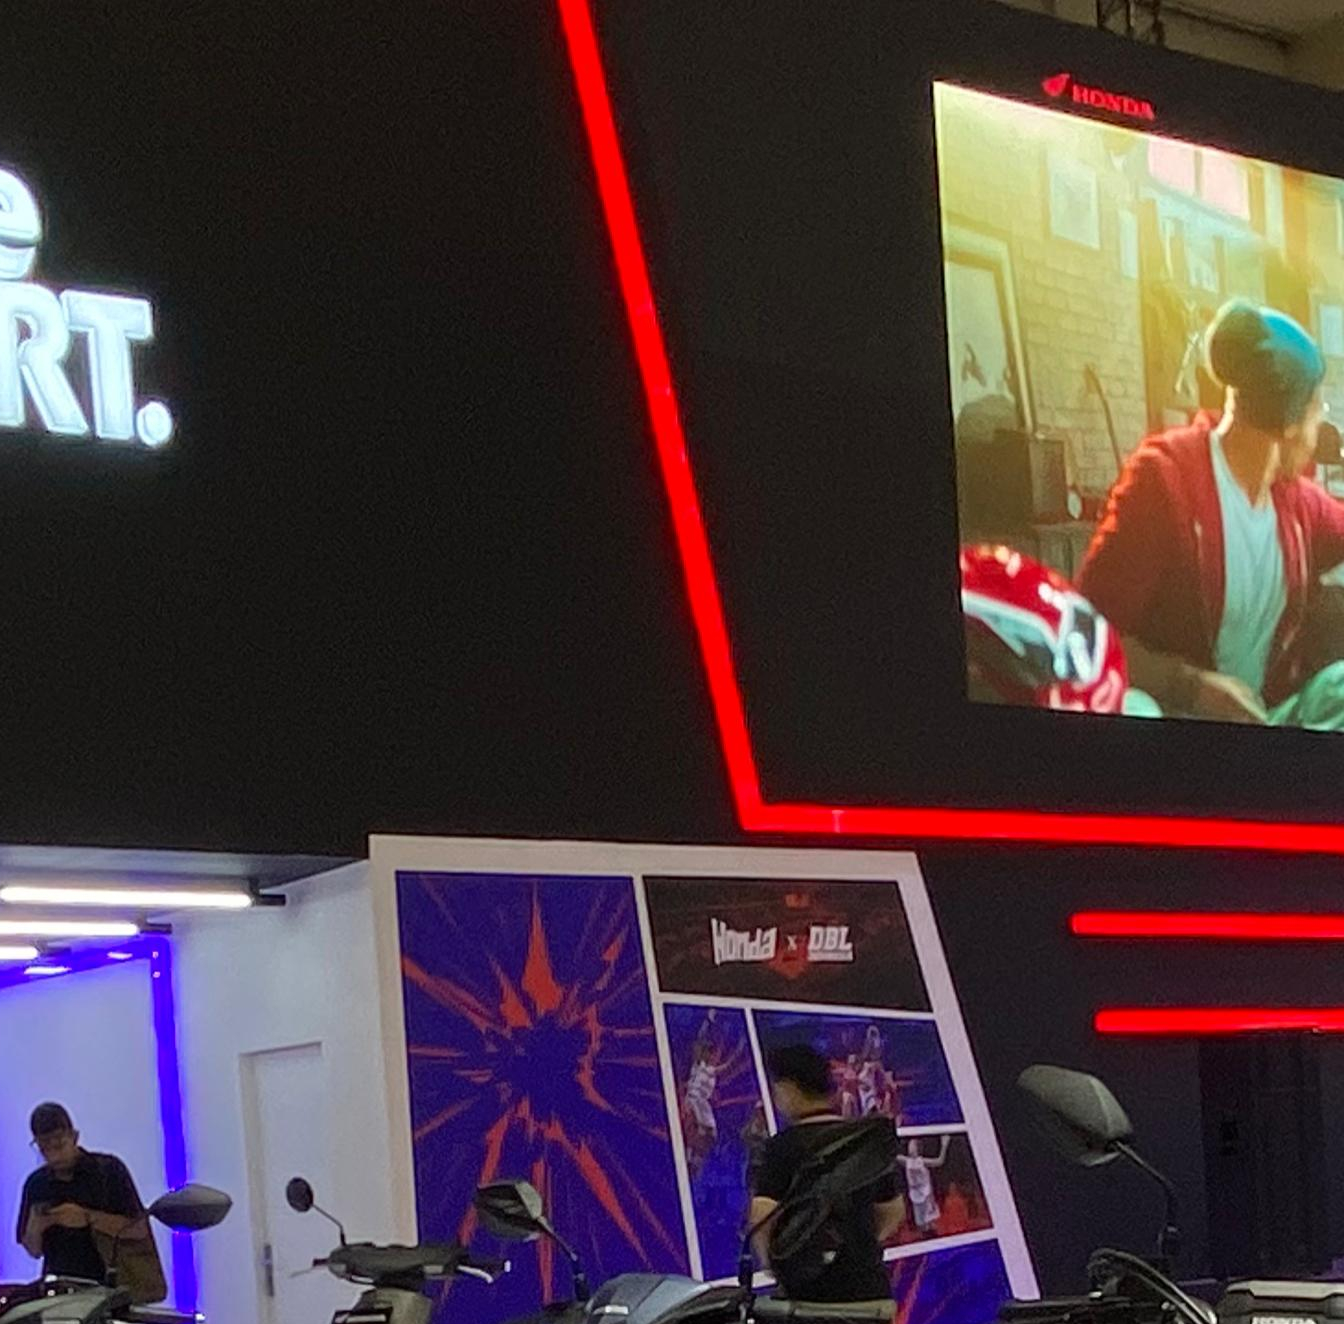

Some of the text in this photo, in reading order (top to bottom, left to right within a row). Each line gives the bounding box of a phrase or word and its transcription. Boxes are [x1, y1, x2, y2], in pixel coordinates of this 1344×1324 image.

[1072, 84, 1155, 120] HONDA
[711, 918, 777, 965] Honda
[808, 926, 853, 950] DBL
